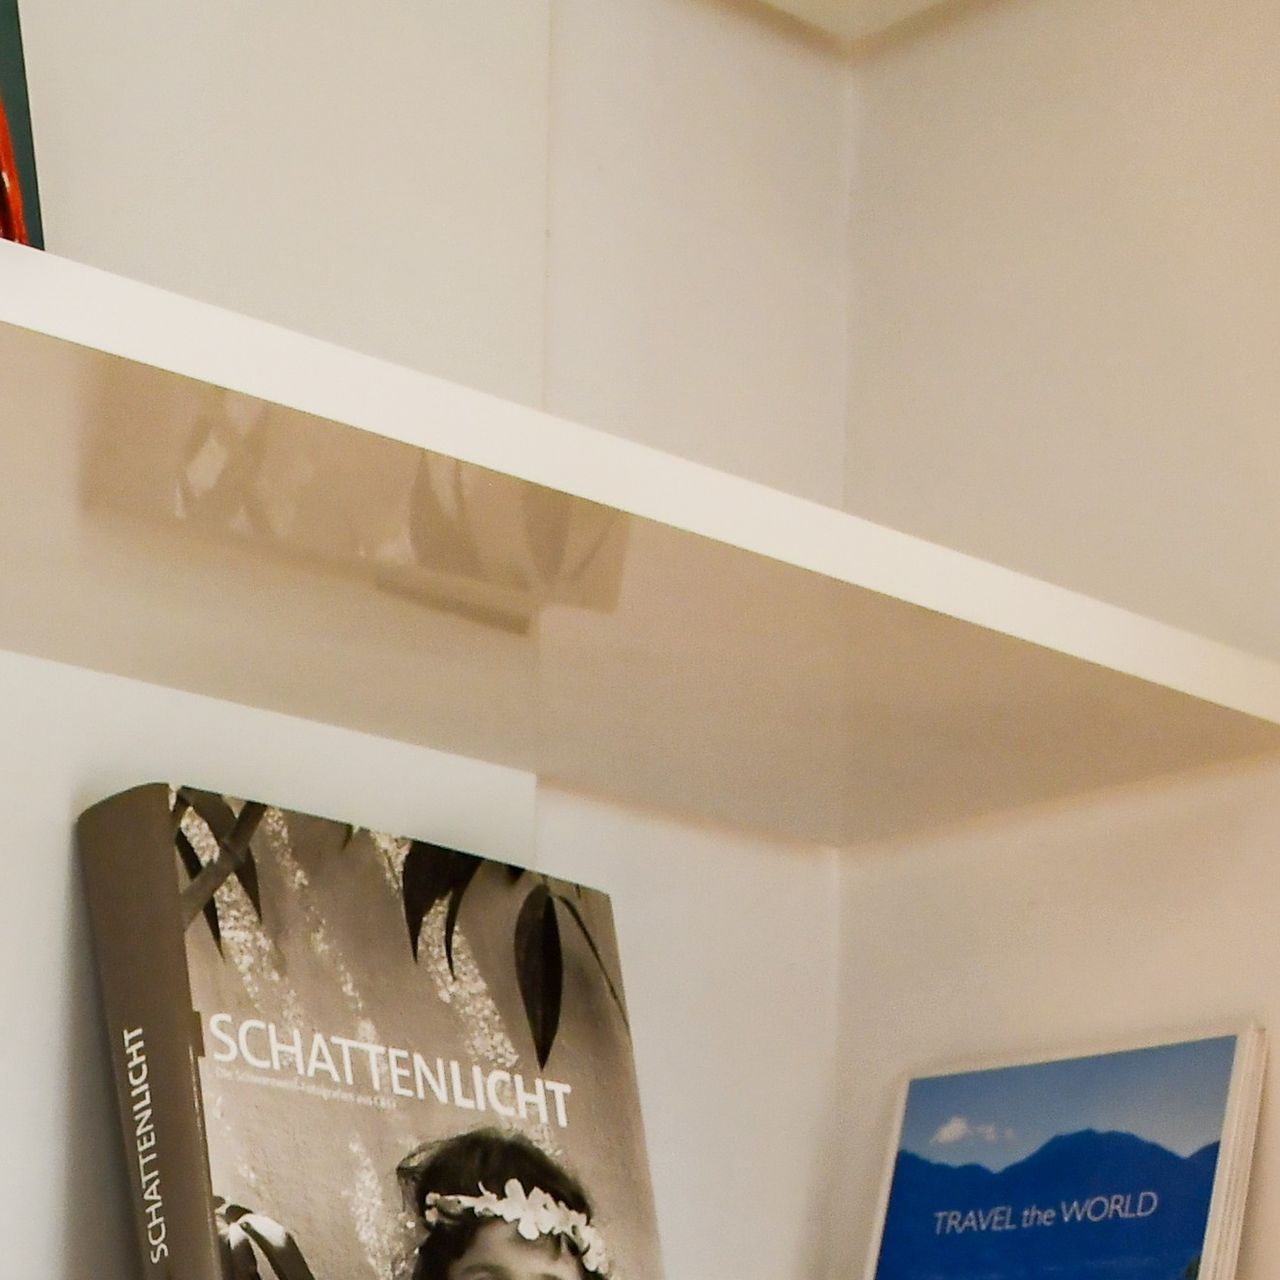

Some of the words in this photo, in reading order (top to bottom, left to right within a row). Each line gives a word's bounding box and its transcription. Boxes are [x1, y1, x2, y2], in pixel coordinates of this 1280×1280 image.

[208, 1012, 572, 1128] SCHATTENLICHT
[123, 1026, 169, 1265] SCHATTENLICHT
[933, 1206, 1017, 1236] TRAVEL
[1021, 1204, 1057, 1228] the
[1060, 1191, 1159, 1223] WORLD
